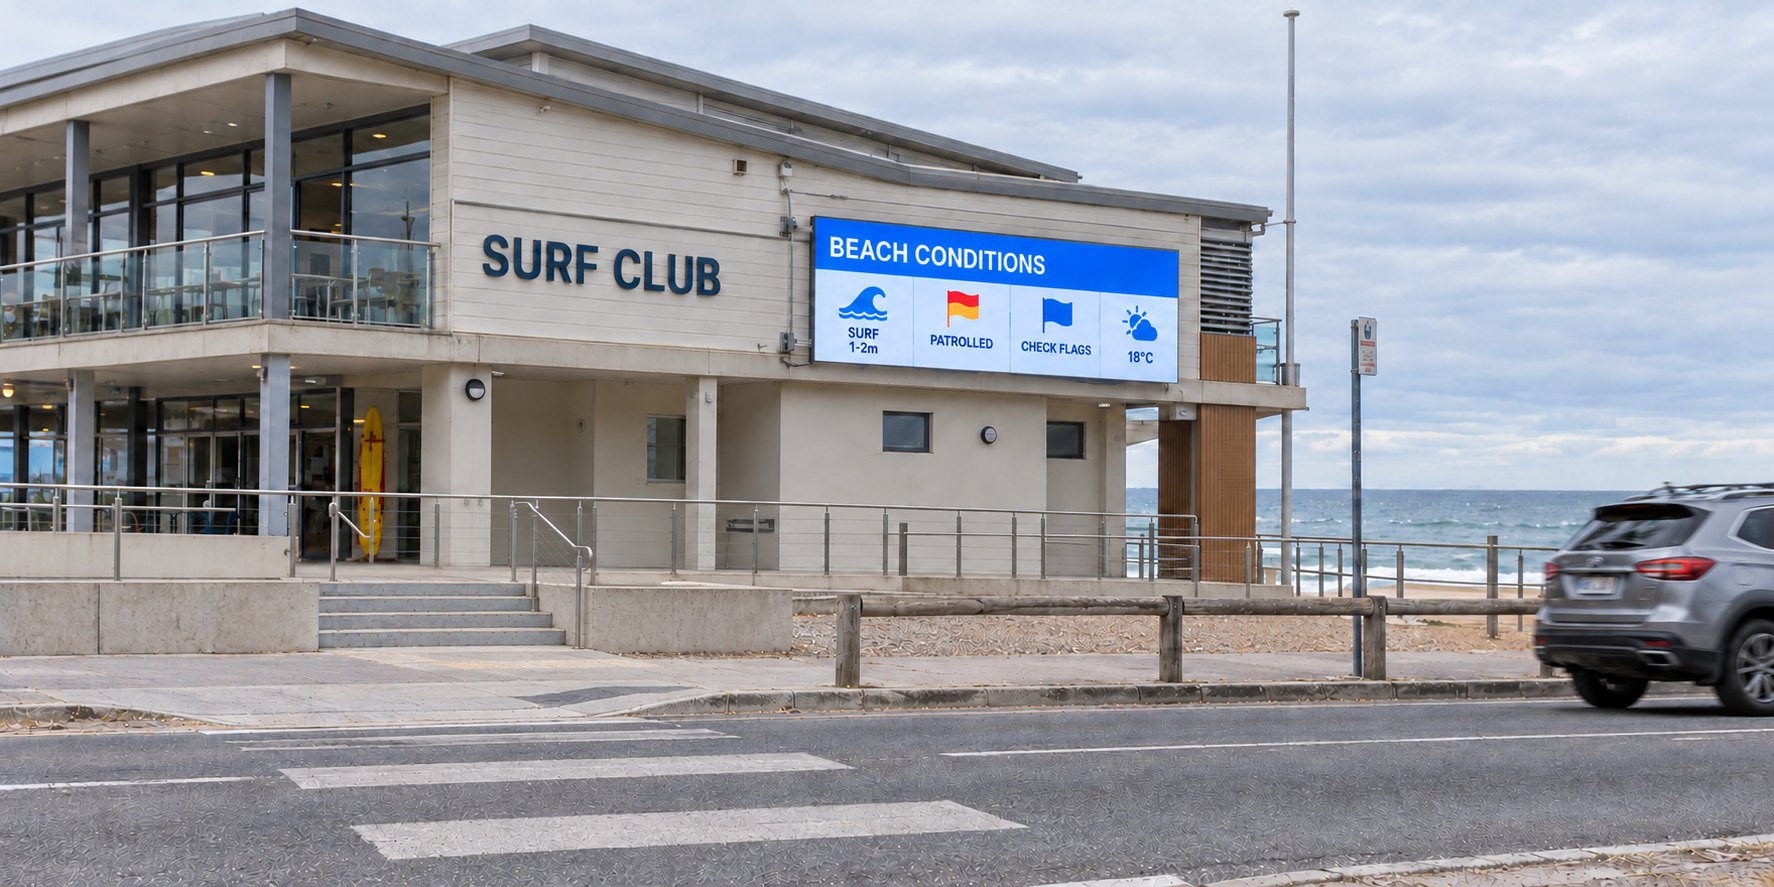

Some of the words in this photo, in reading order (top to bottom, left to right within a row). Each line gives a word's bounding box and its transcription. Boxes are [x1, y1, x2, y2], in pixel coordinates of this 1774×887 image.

[829, 236, 908, 264] BEACH
[915, 243, 1046, 275] CONDITIONS
[483, 234, 599, 286] SURF
[612, 248, 722, 298] CLUB
[848, 326, 880, 340] SURF
[849, 341, 878, 355] 1-2m
[930, 334, 994, 350] PATROLLED
[1021, 340, 1056, 354] CHECK
[1059, 343, 1092, 356] FLAGS
[1127, 350, 1154, 364] 18°C
